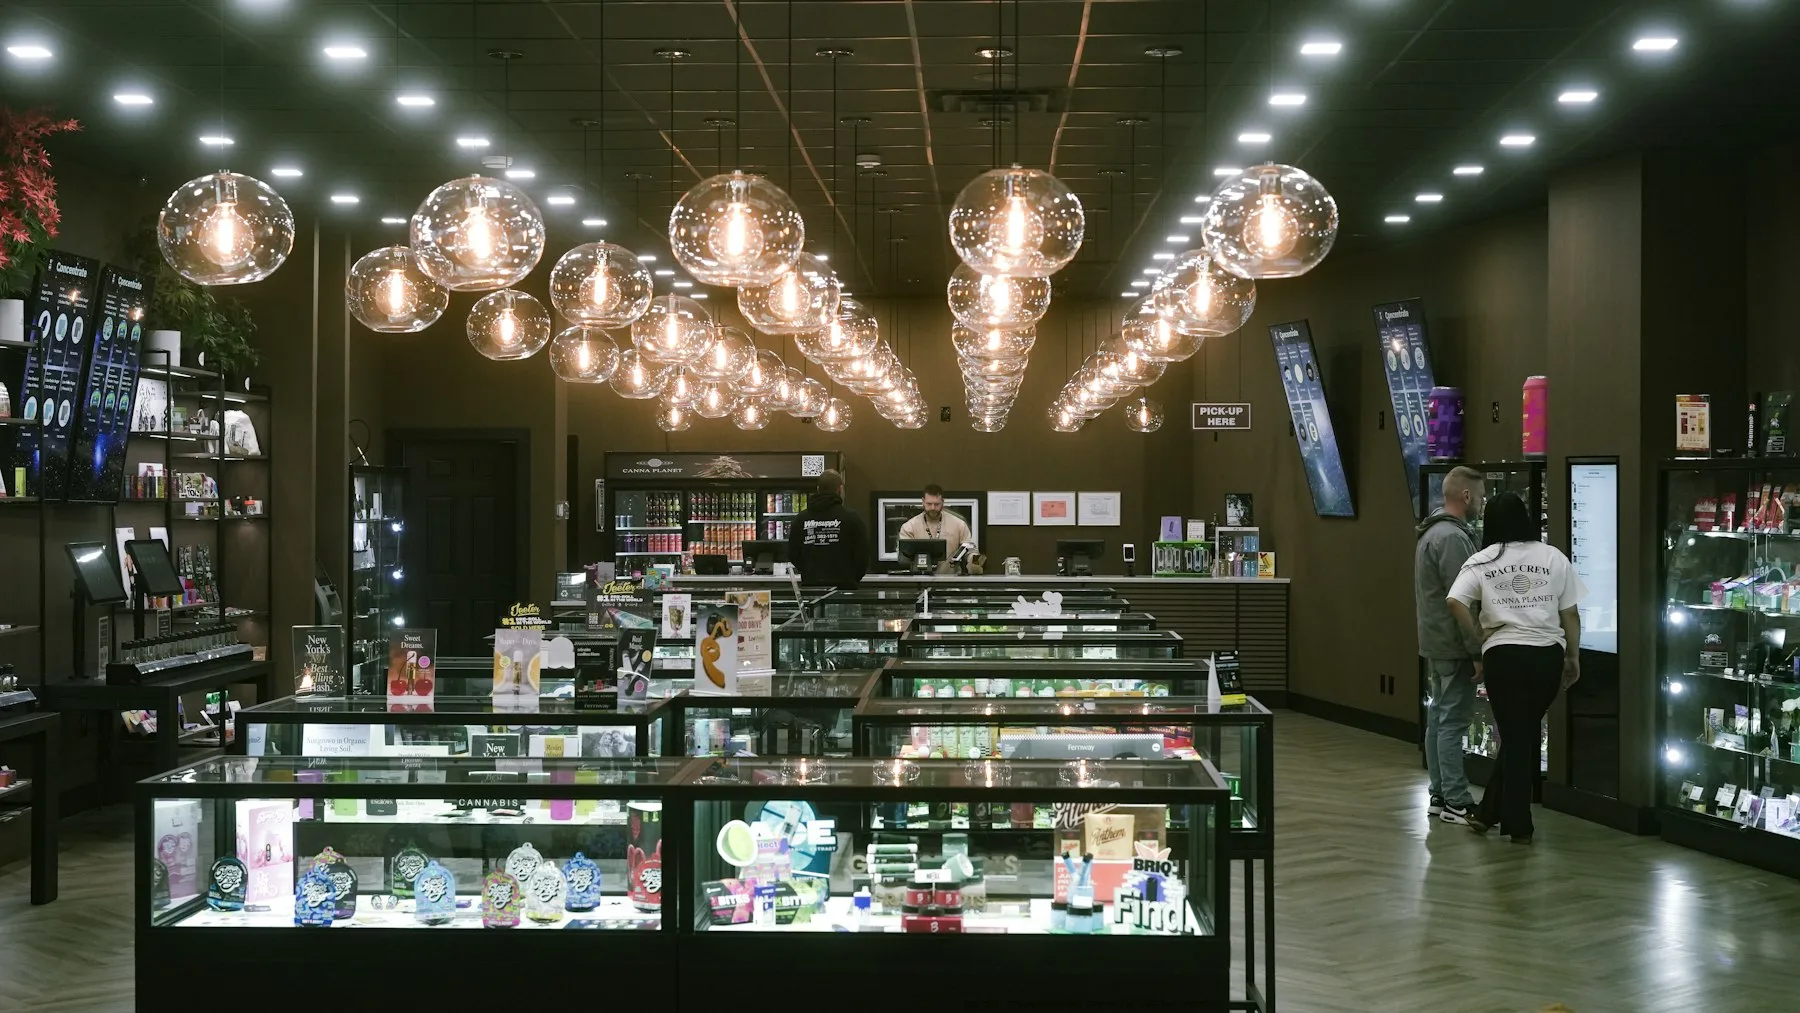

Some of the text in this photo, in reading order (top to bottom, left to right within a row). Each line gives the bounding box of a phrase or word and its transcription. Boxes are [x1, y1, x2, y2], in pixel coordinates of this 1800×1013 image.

[56, 261, 88, 278] Concentrate
[117, 276, 143, 290] Concentrate
[1200, 406, 1243, 415] PICK-UP
[1207, 417, 1236, 426] HERE
[804, 519, 842, 528] Winsupply
[1485, 564, 1550, 581] SPACE CREW
[603, 580, 635, 594] Jeeter
[1491, 594, 1554, 605] CANNA PLANET
[510, 602, 540, 617] Jeeter
[308, 635, 327, 645] New
[404, 634, 421, 642] Sweet
[305, 644, 331, 654] York's
[401, 641, 424, 649] Dreams.
[311, 663, 328, 673] Best
[311, 673, 334, 683] elling
[343, 737, 367, 745] Organic
[486, 743, 505, 753] New
[1067, 743, 1096, 752] Fernway
[458, 798, 519, 807] CANNABIS
[1134, 858, 1172, 877] BRIQ
